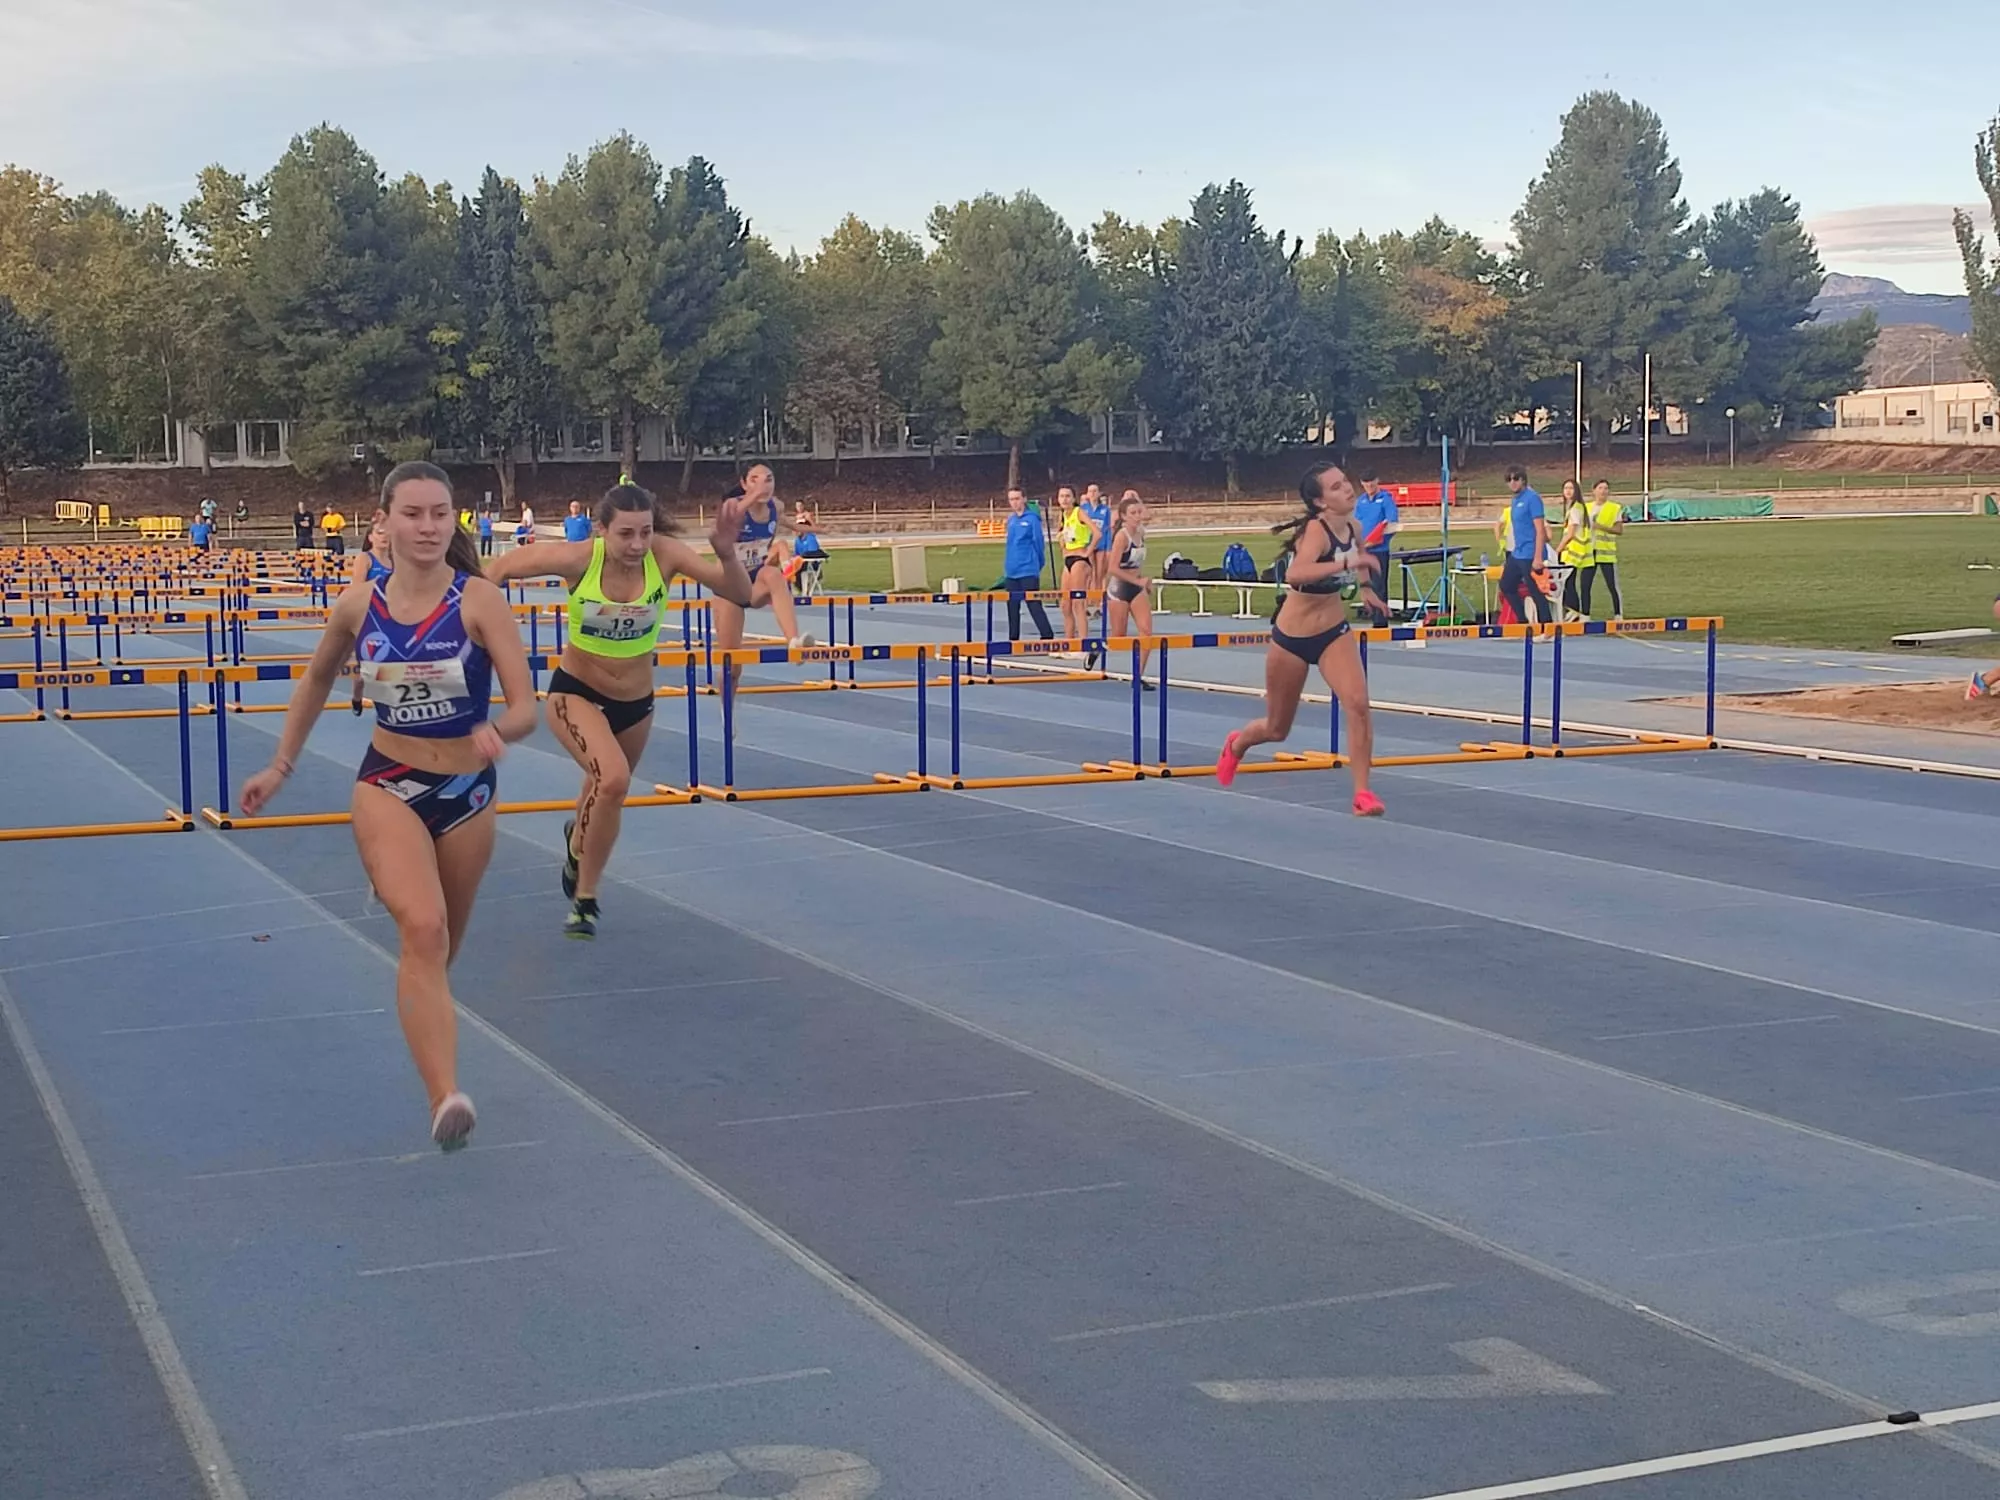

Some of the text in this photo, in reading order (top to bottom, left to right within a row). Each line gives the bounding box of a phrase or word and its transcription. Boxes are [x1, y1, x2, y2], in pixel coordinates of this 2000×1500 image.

[611, 618, 635, 630] 19
[1616, 621, 1656, 631] MONDO
[1426, 628, 1468, 638] MONDO
[1024, 642, 1070, 652] MONDO
[801, 649, 850, 660] MONDO
[35, 673, 95, 685] MONDO
[395, 682, 432, 703] 23
